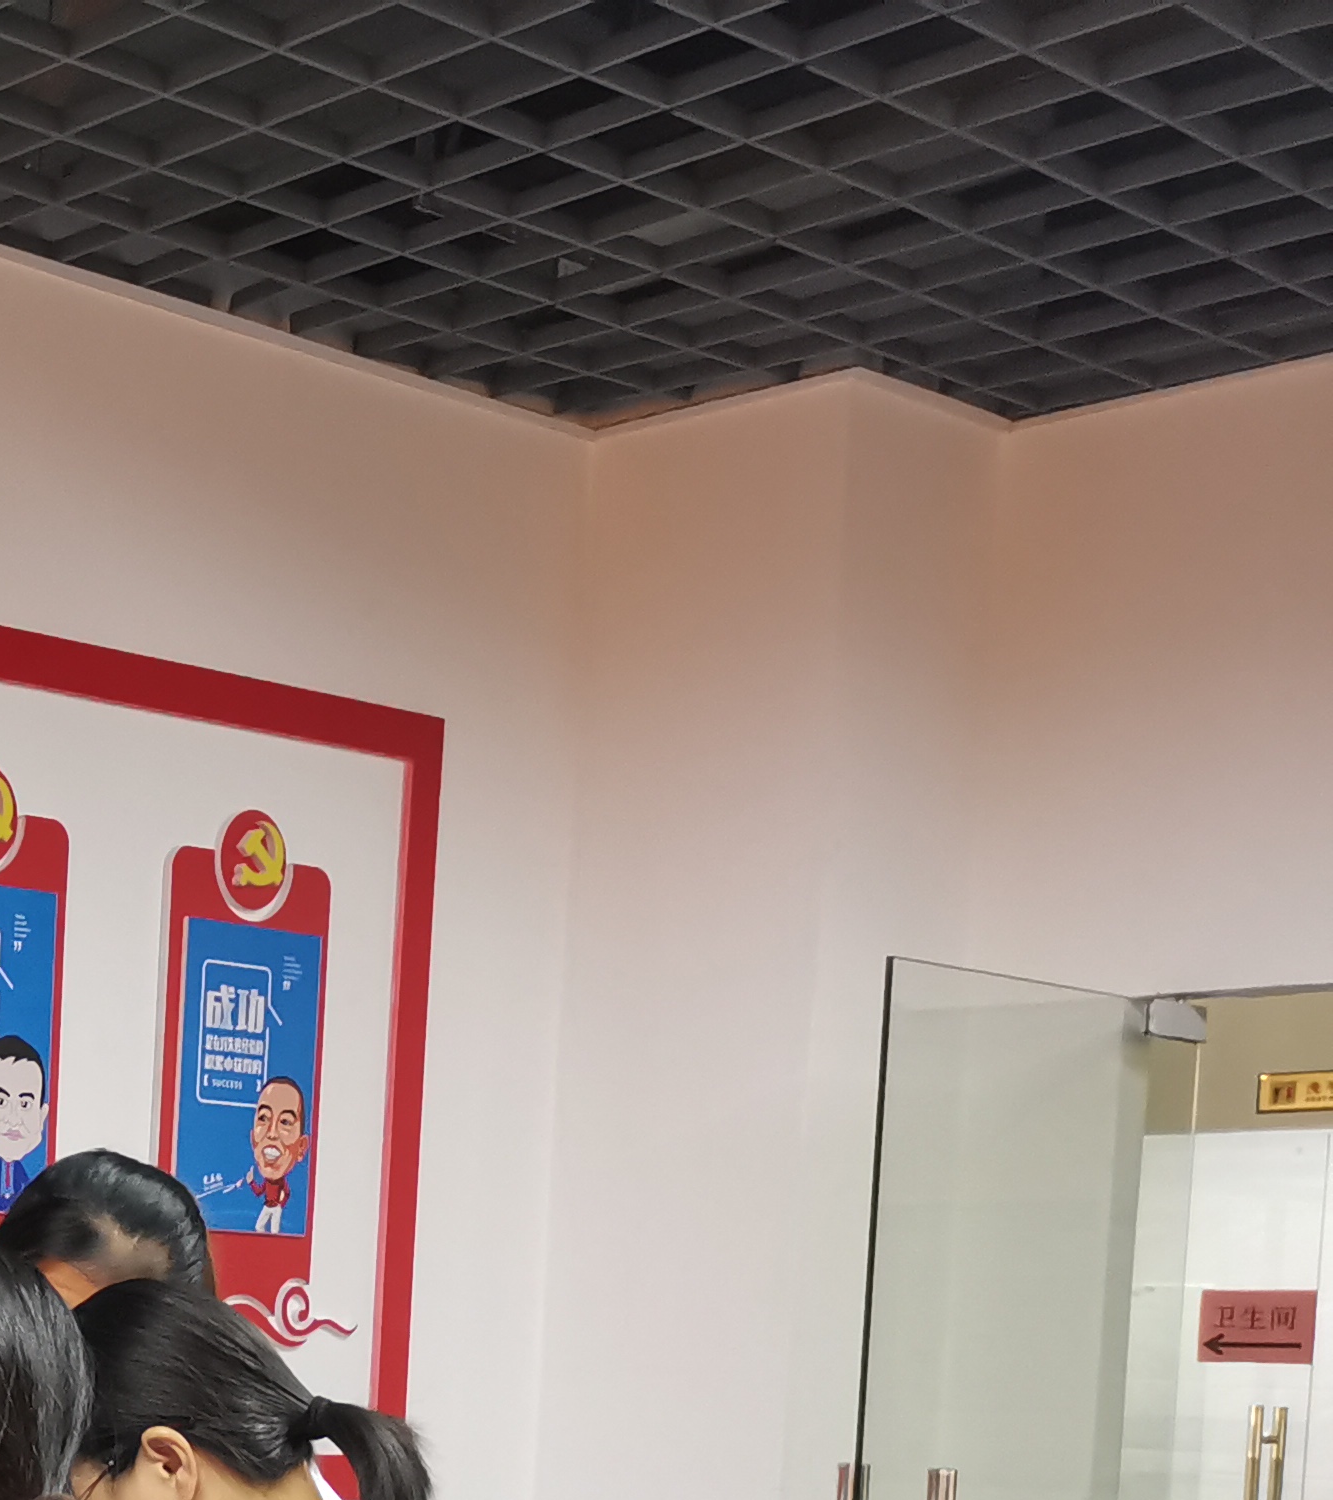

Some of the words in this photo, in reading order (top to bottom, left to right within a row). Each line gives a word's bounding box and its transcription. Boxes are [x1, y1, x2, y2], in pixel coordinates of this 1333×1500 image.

[205, 984, 265, 1034] 成功
[1213, 1305, 1297, 1331] 卫生间
